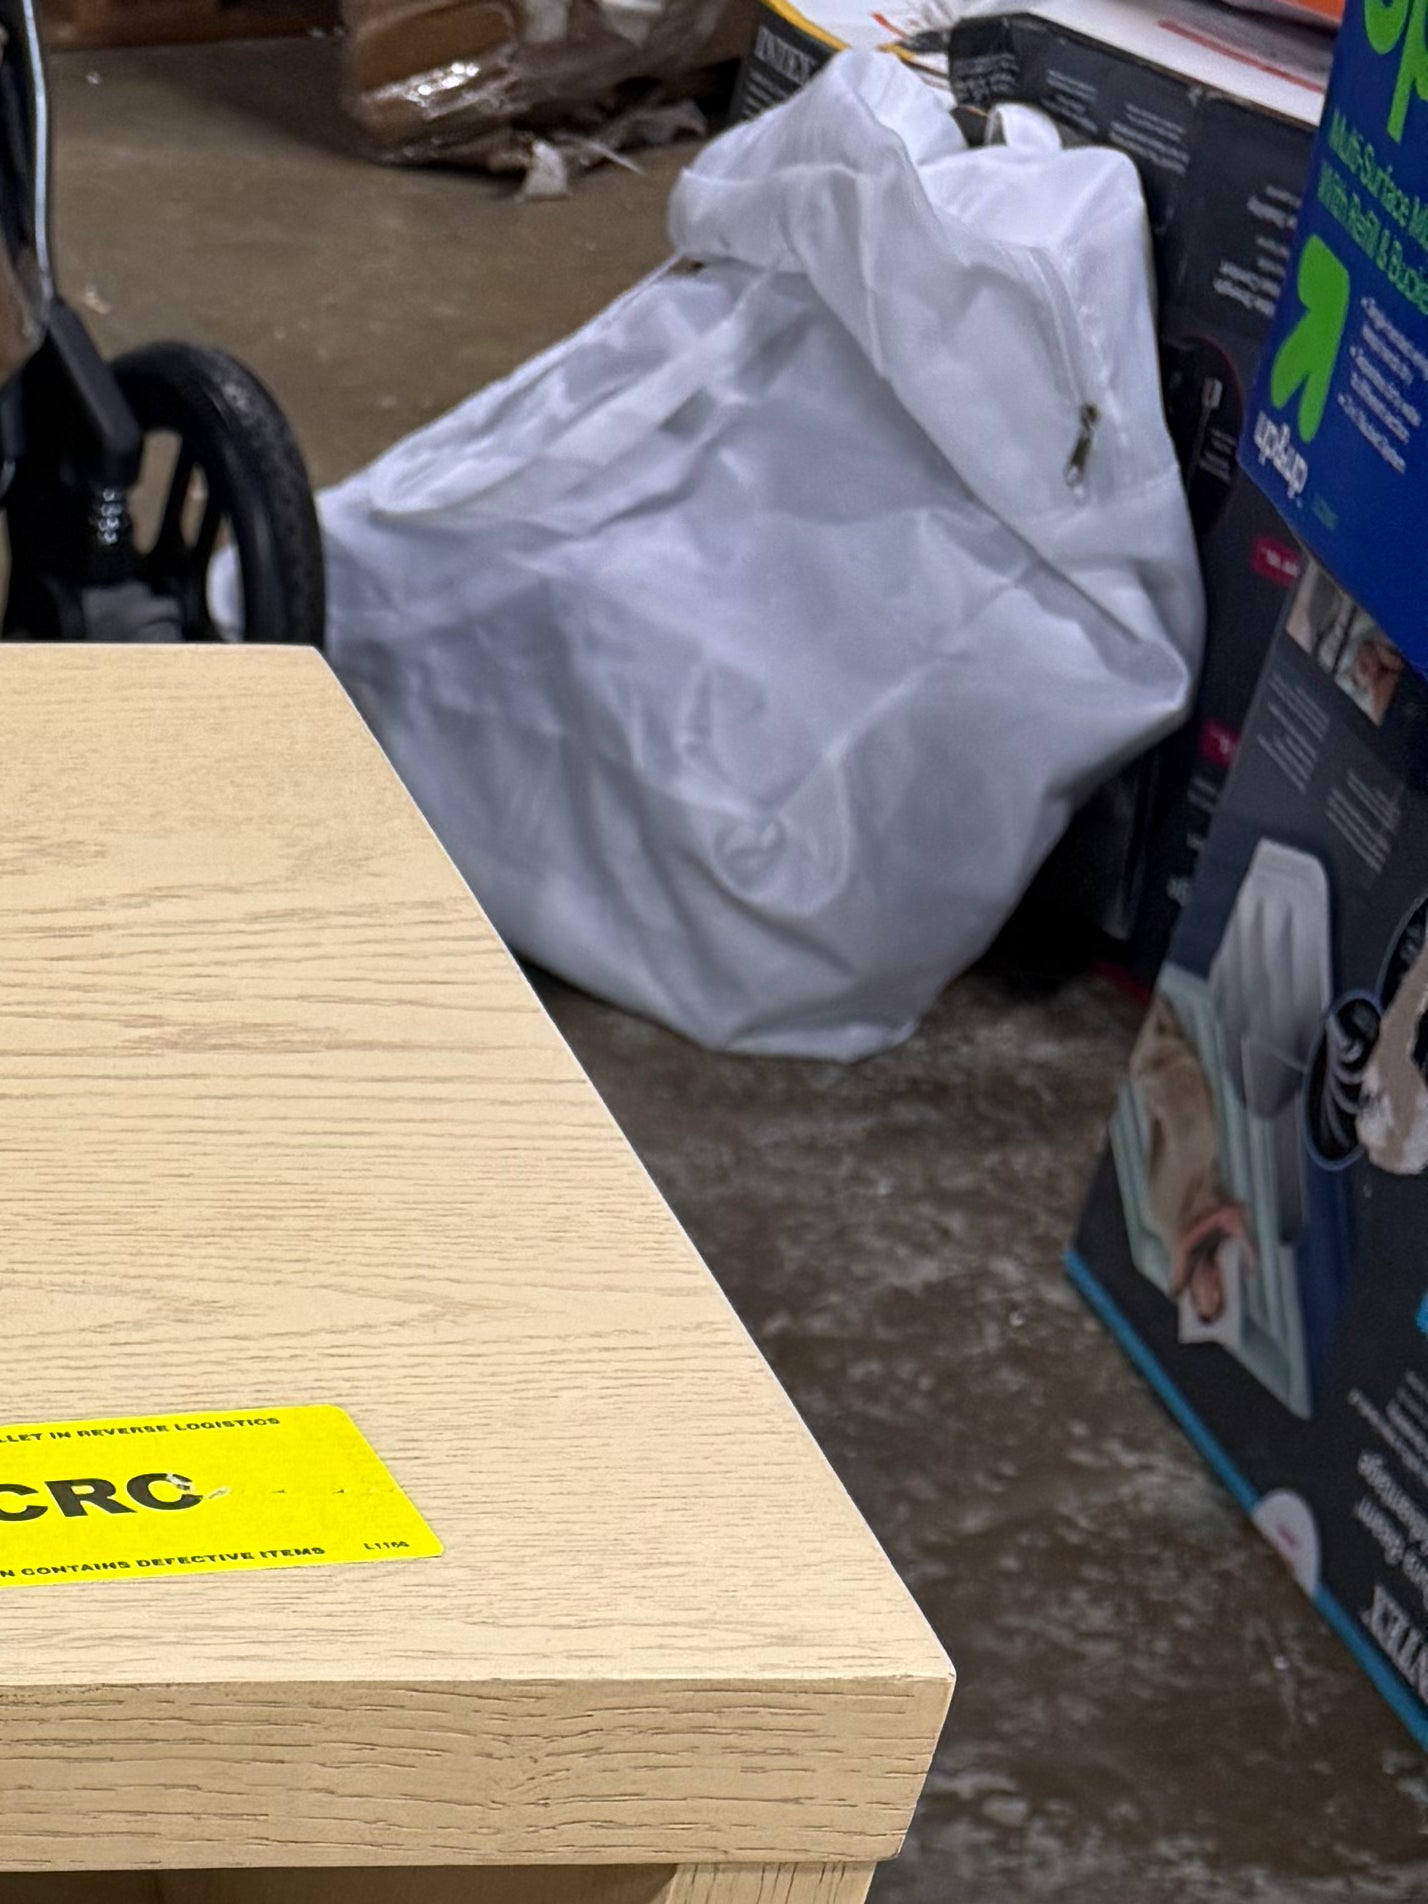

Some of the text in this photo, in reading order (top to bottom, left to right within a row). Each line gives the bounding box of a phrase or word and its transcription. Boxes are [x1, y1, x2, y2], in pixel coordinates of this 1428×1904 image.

[49, 1429, 72, 1440] IN
[76, 1422, 169, 1439] REVERSE
[174, 1416, 282, 1432] LOGISTICS
[21, 1559, 130, 1578] CONTAINS
[136, 1551, 255, 1569] DEFECTIVE
[260, 1546, 325, 1559] ITEMS
